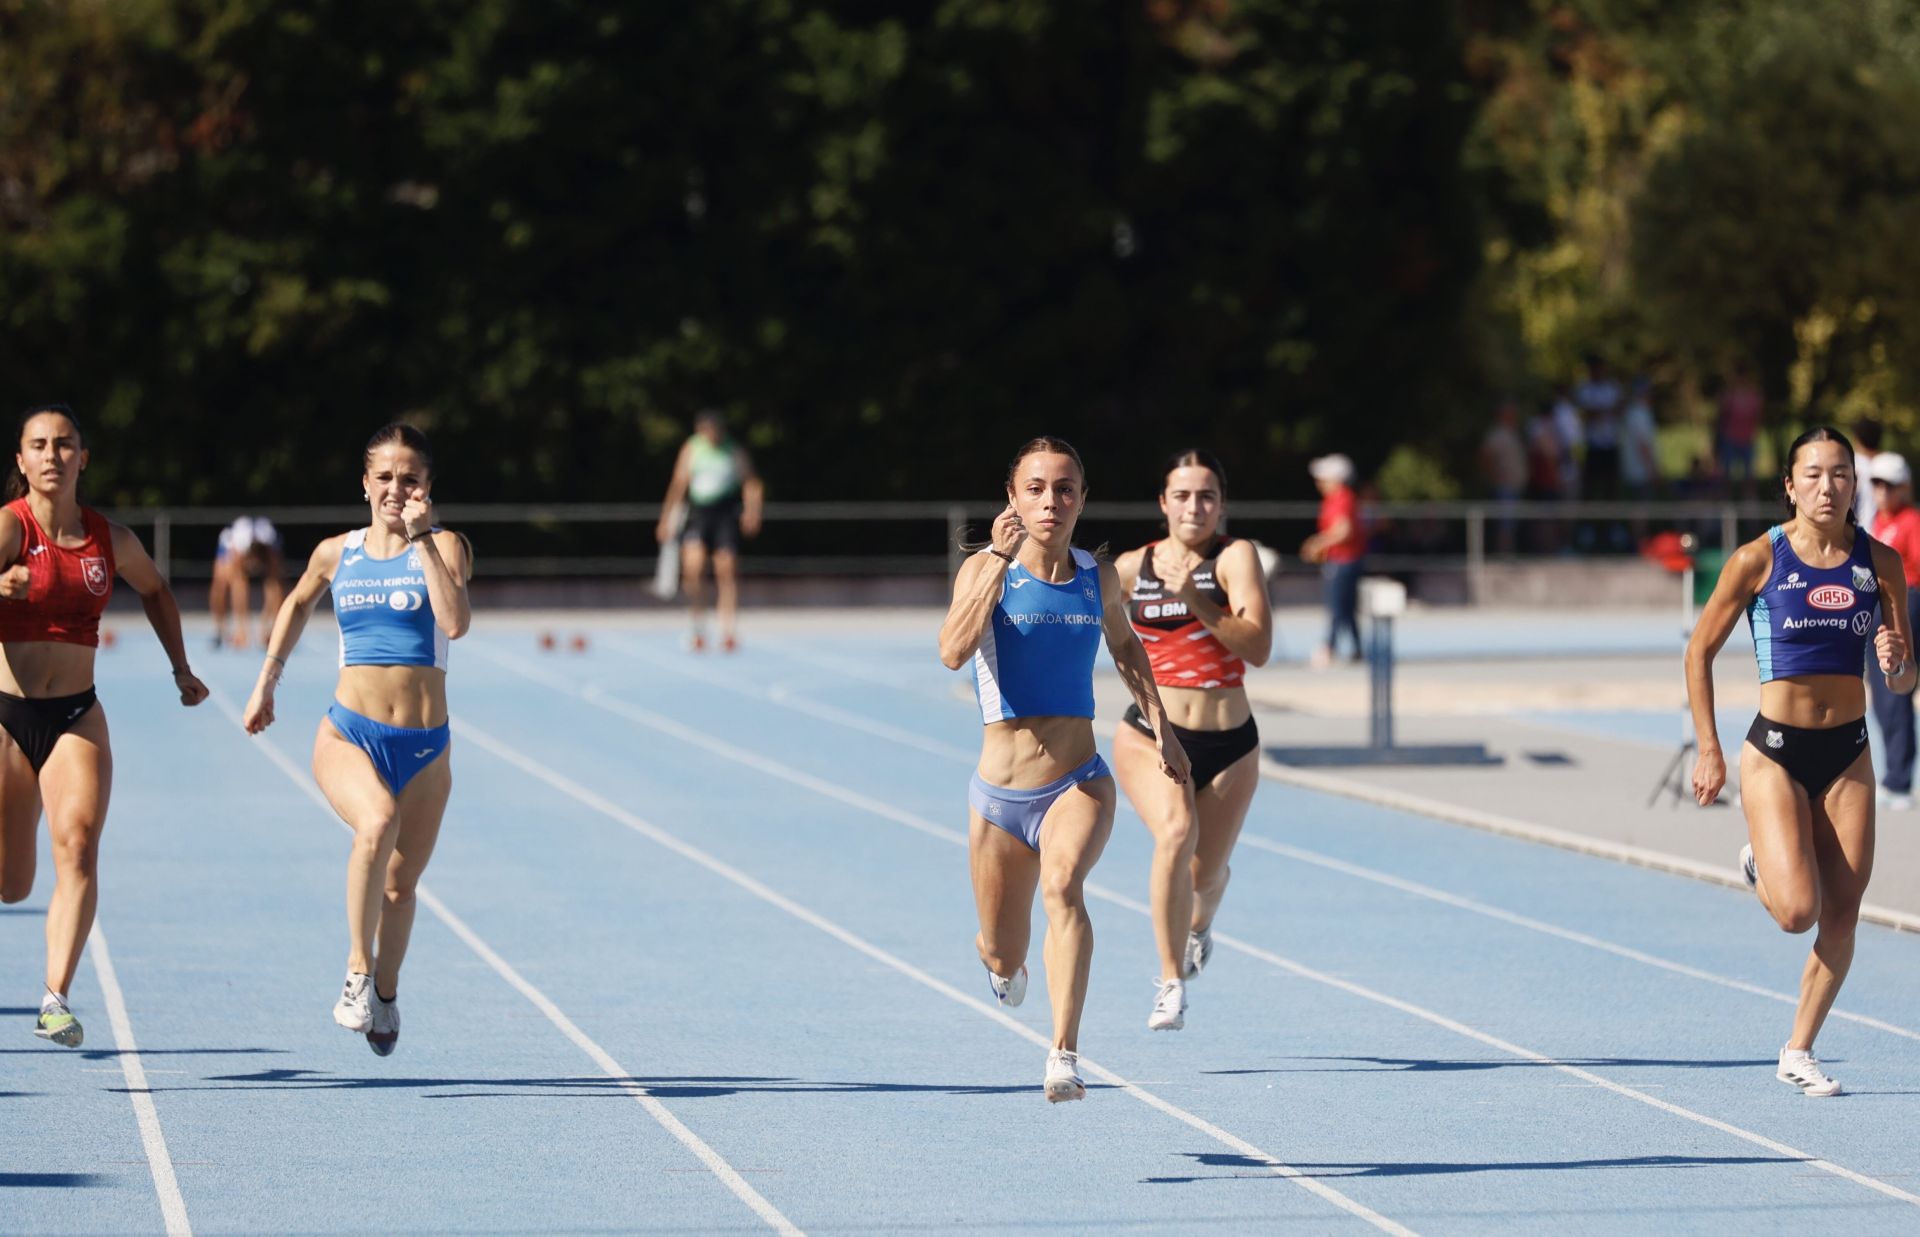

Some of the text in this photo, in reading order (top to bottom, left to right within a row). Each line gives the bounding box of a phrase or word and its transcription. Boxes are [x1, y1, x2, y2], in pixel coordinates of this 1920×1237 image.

[1777, 581, 1808, 590] VIATOR
[340, 594, 386, 608] BED4U
[1003, 613, 1063, 626] GIPUZKOA
[1782, 616, 1848, 630] Autowag
